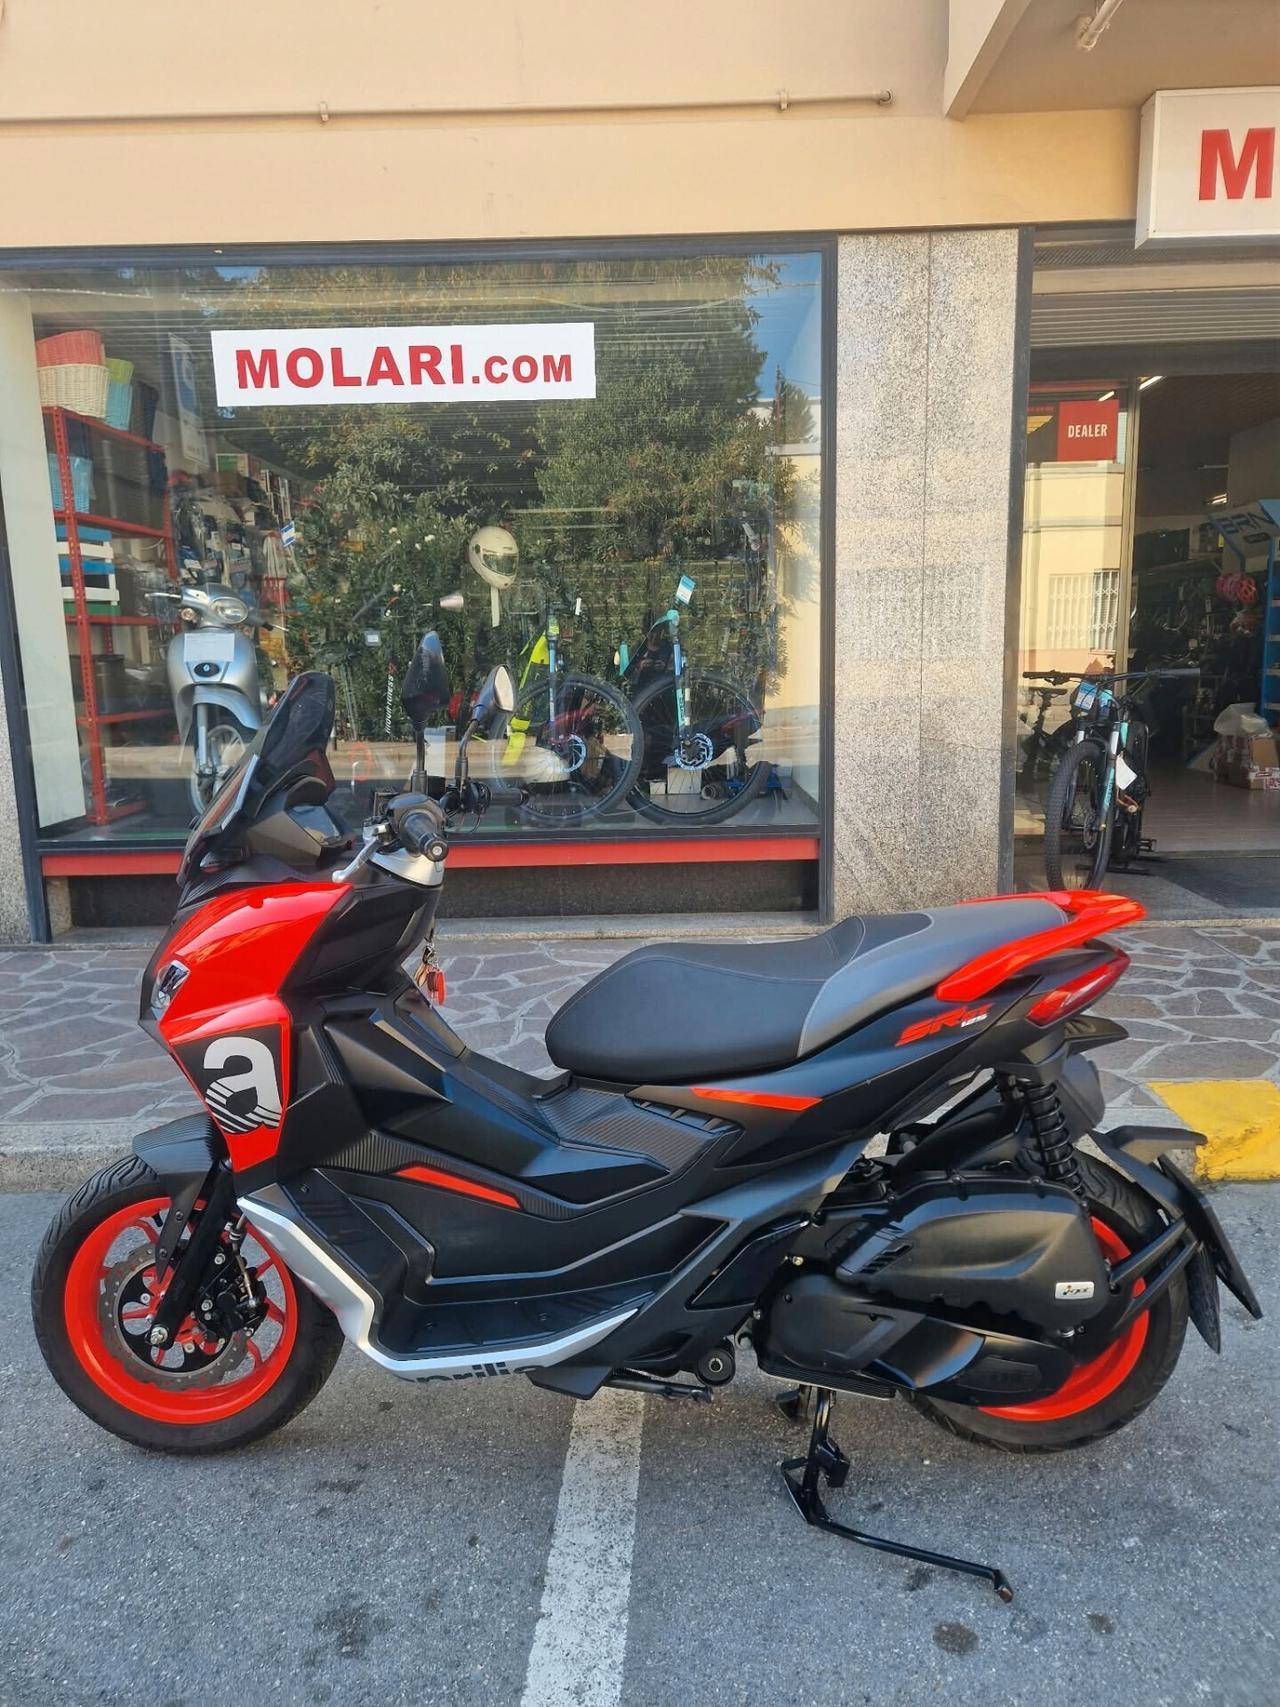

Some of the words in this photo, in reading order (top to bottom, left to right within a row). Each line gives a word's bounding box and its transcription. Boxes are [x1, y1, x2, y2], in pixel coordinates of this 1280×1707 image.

[1199, 127, 1276, 200] M
[236, 344, 573, 389] MOLARI.COM
[1067, 424, 1108, 438] DEALER
[394, 1361, 546, 1383] prili
